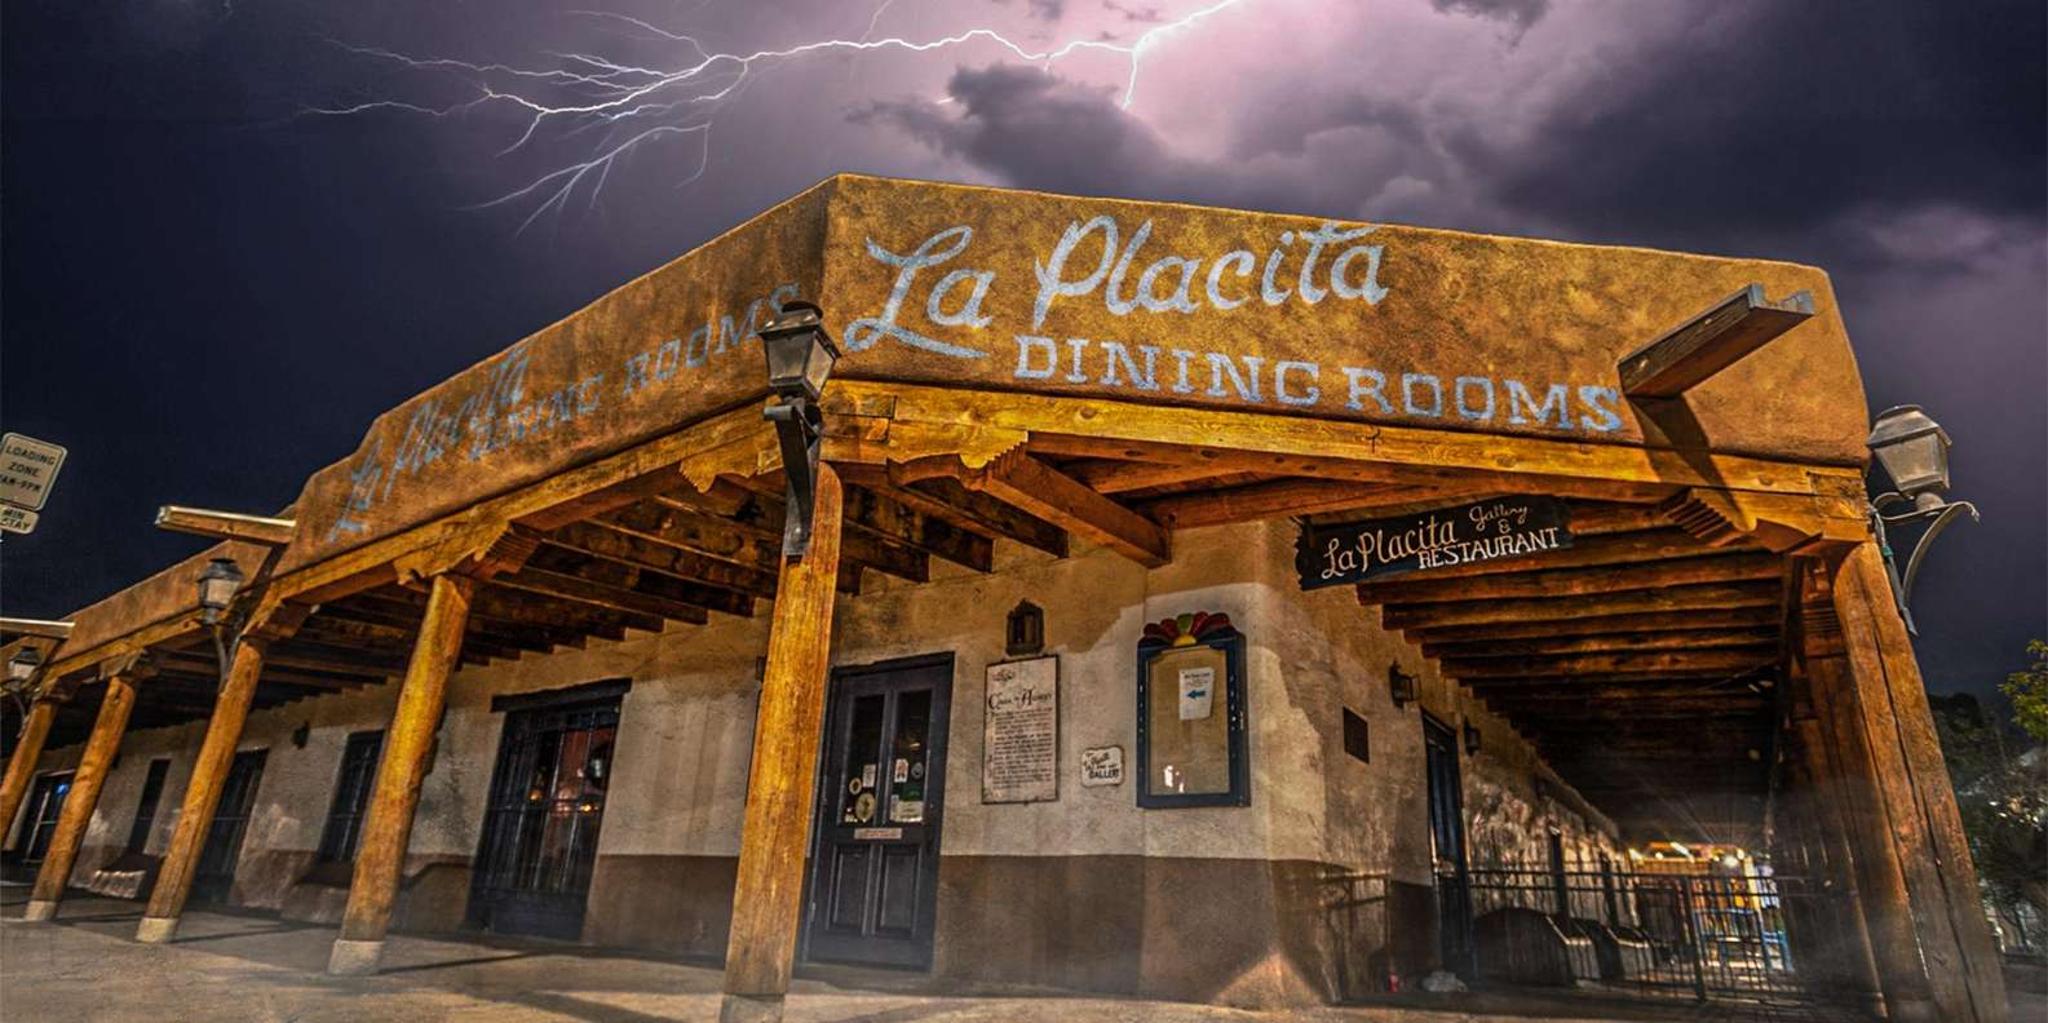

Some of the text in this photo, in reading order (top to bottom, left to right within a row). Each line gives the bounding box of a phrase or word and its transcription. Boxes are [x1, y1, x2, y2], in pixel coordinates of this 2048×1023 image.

[844, 215, 1389, 358] La Placita
[1014, 334, 1623, 431] DINING ROOMS
[6, 445, 56, 466] LOADING
[8, 462, 41, 477] ZONE
[1321, 538, 1359, 580] La
[1356, 515, 1460, 573] Placita
[1418, 527, 1559, 570] RESTAURANT
